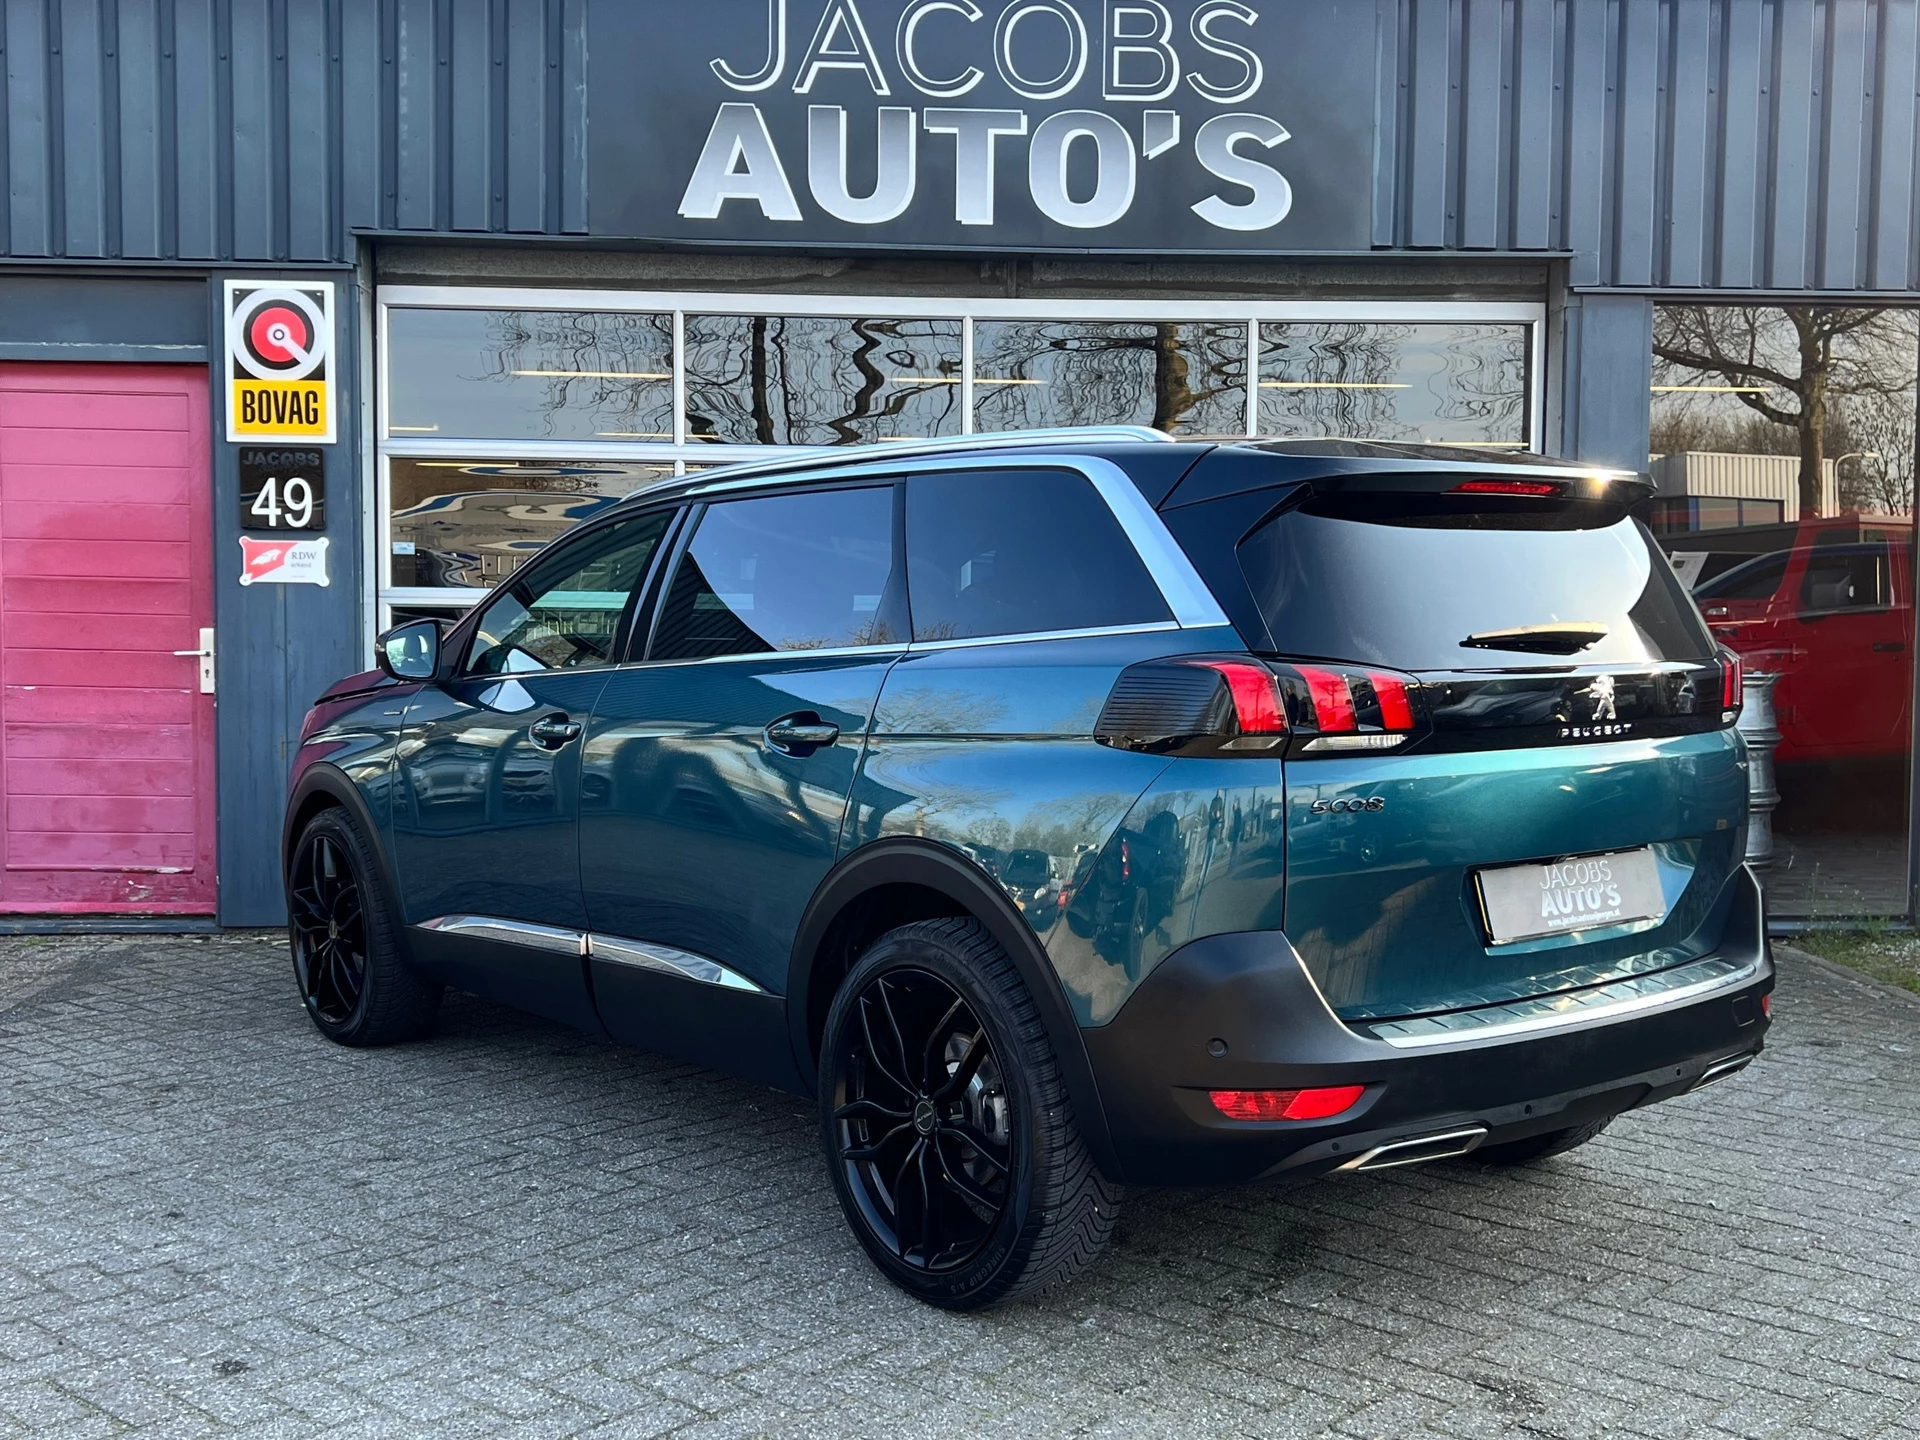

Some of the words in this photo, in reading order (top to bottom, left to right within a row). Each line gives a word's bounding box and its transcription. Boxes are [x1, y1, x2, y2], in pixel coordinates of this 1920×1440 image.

[709, 0, 1264, 103] JACOBS
[677, 102, 1292, 231] AUTO'S
[241, 389, 319, 425] BOVAG
[243, 451, 320, 467] JACOBS
[251, 477, 313, 528] 49
[291, 551, 317, 560] RDW
[1561, 723, 1632, 738] PEUGEOT
[1310, 796, 1385, 815] 5008
[1539, 860, 1612, 889] JACOBS
[1541, 882, 1622, 917] AUTO'S
